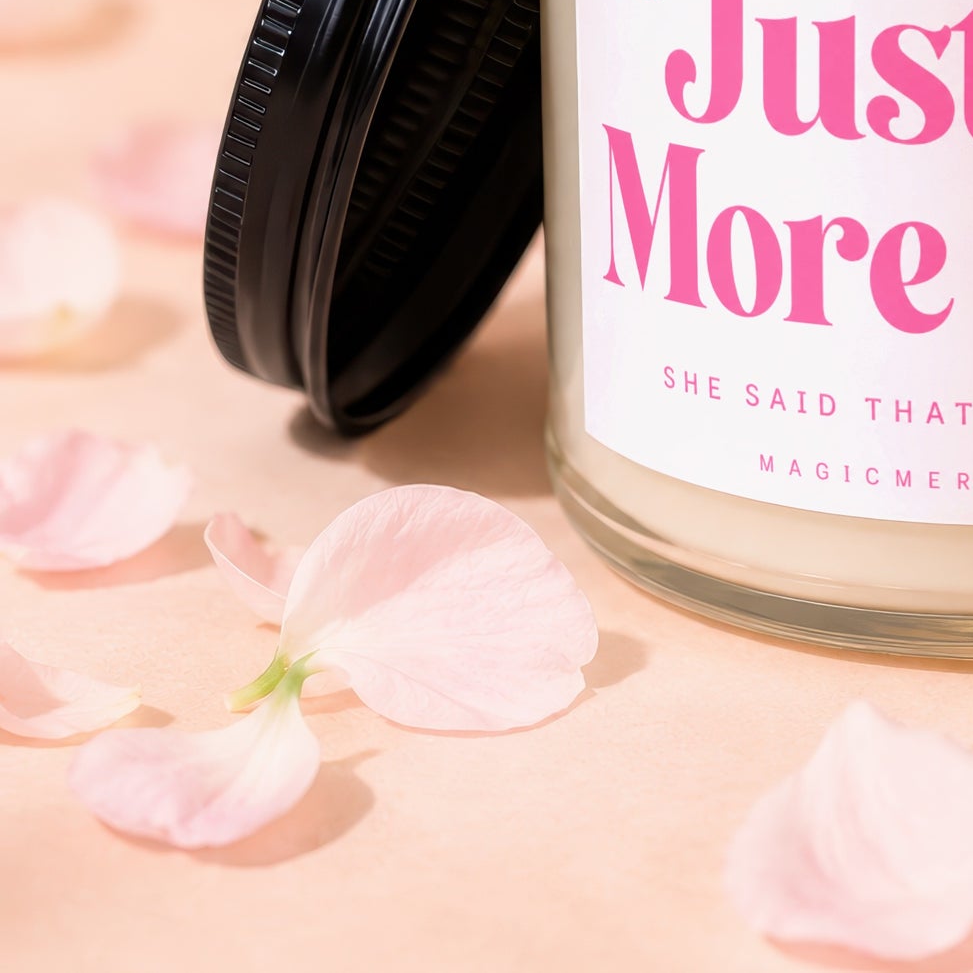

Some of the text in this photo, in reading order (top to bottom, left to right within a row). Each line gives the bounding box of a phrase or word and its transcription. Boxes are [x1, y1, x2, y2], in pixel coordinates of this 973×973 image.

[601, 123, 955, 335] More
[662, 364, 721, 400] SHE
[744, 383, 837, 417] SAID
[864, 397, 973, 425] THAT
